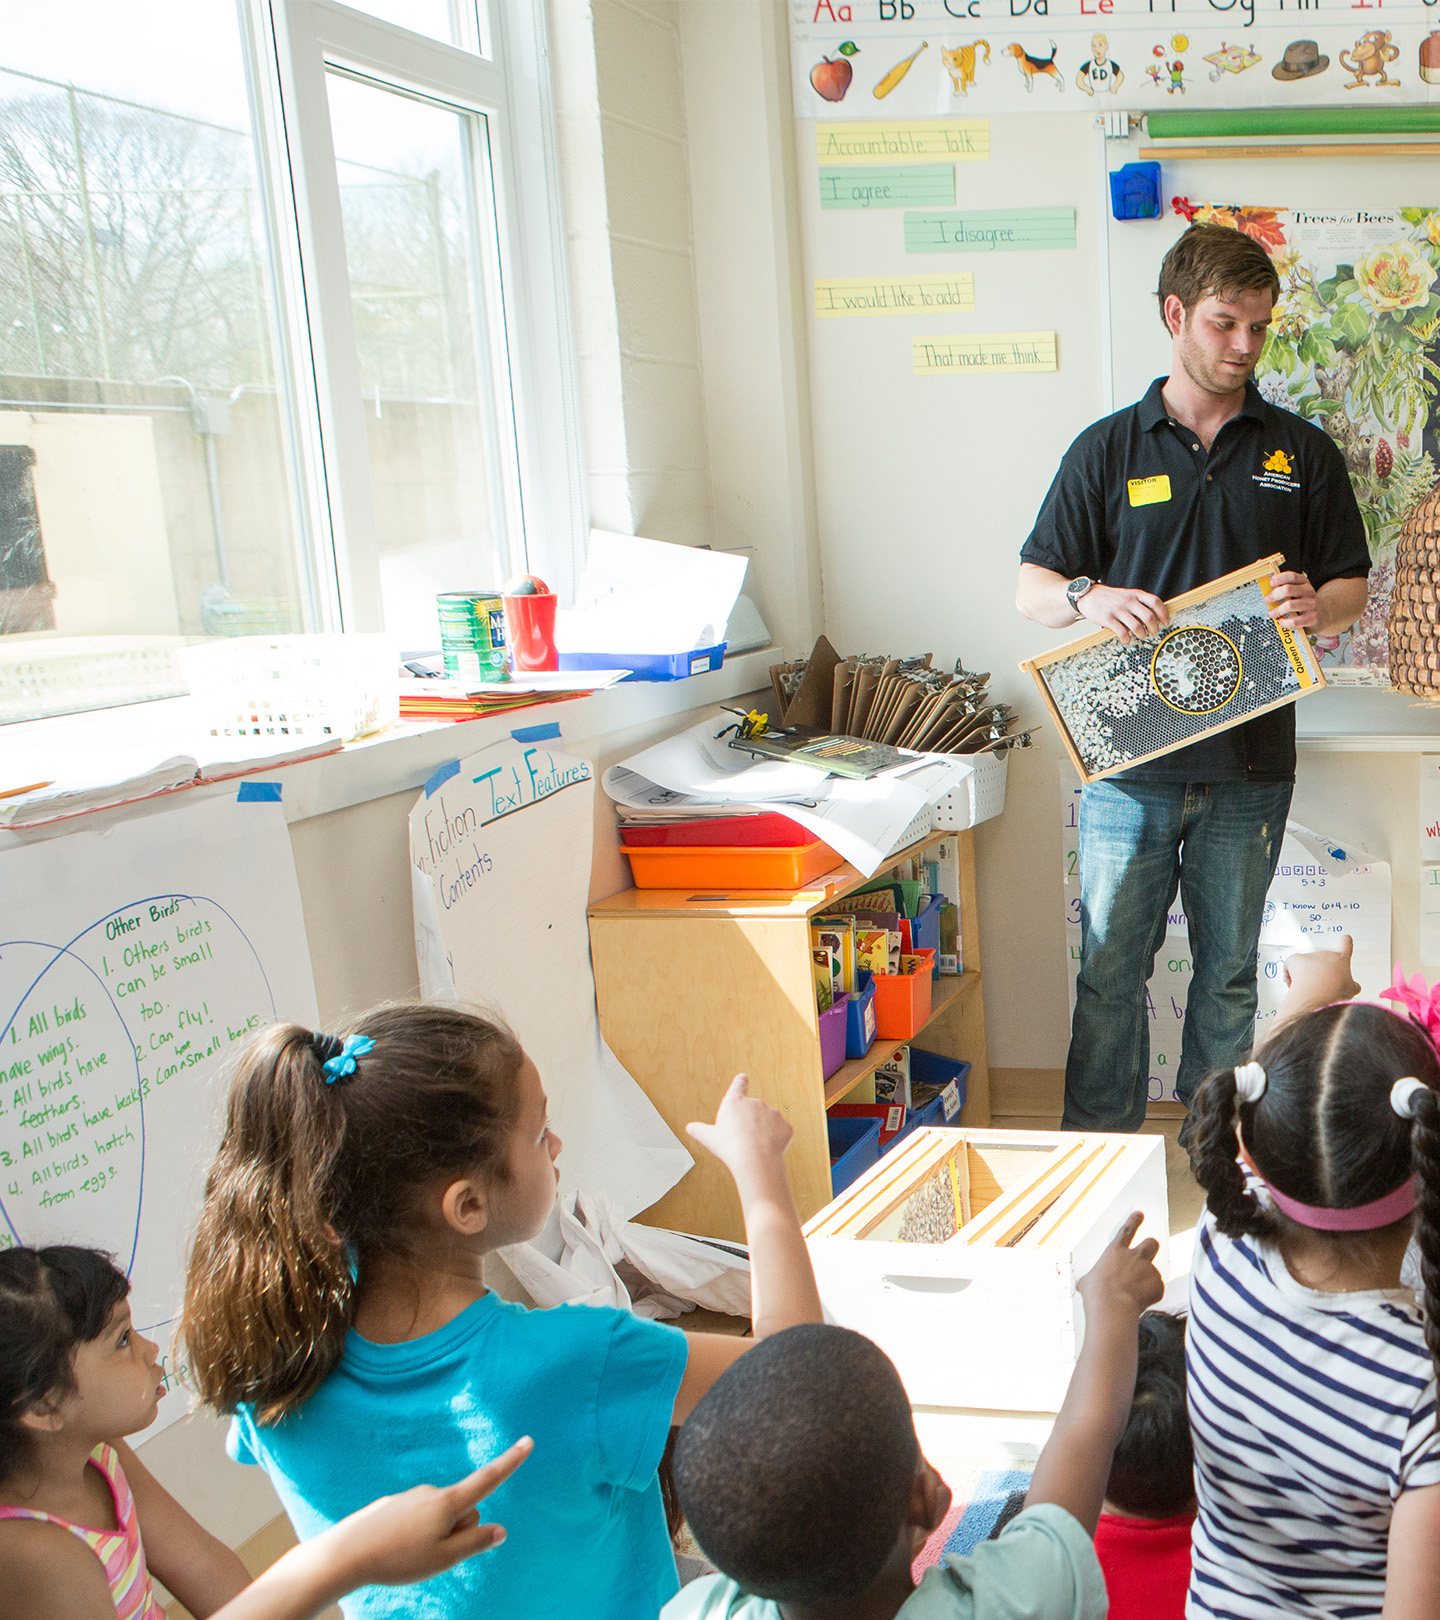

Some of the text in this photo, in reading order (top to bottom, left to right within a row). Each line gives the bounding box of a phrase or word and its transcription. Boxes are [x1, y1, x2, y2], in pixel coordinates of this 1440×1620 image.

[1092, 68, 1109, 81] ED
[937, 130, 975, 153] Talk
[826, 176, 844, 200] I
[933, 220, 950, 244] I
[1292, 211, 1395, 226] Trees for Bees
[843, 285, 887, 309] would
[891, 285, 916, 307] like
[919, 284, 933, 306] to
[922, 343, 953, 367] That
[958, 343, 988, 366] made
[991, 351, 1007, 365] me
[1130, 477, 1157, 487] VISITOR
[1284, 643, 1305, 675] Queen
[472, 748, 589, 816] Text Features
[440, 843, 494, 910] Contents
[106, 898, 181, 940] Other Birds
[123, 919, 212, 967] Others birds
[116, 942, 213, 998] can be small
[1168, 957, 1191, 973] on
[28, 997, 87, 1038] All birds
[178, 1002, 214, 1030] fly!
[37, 1035, 79, 1068] wings.
[13, 1051, 109, 1110] All birds have
[19, 1094, 85, 1129] feathers.
[22, 1106, 114, 1159] All birds have
[31, 1166, 51, 1187] All
[53, 1152, 89, 1180] birds
[38, 1165, 118, 1210] from eggs.
